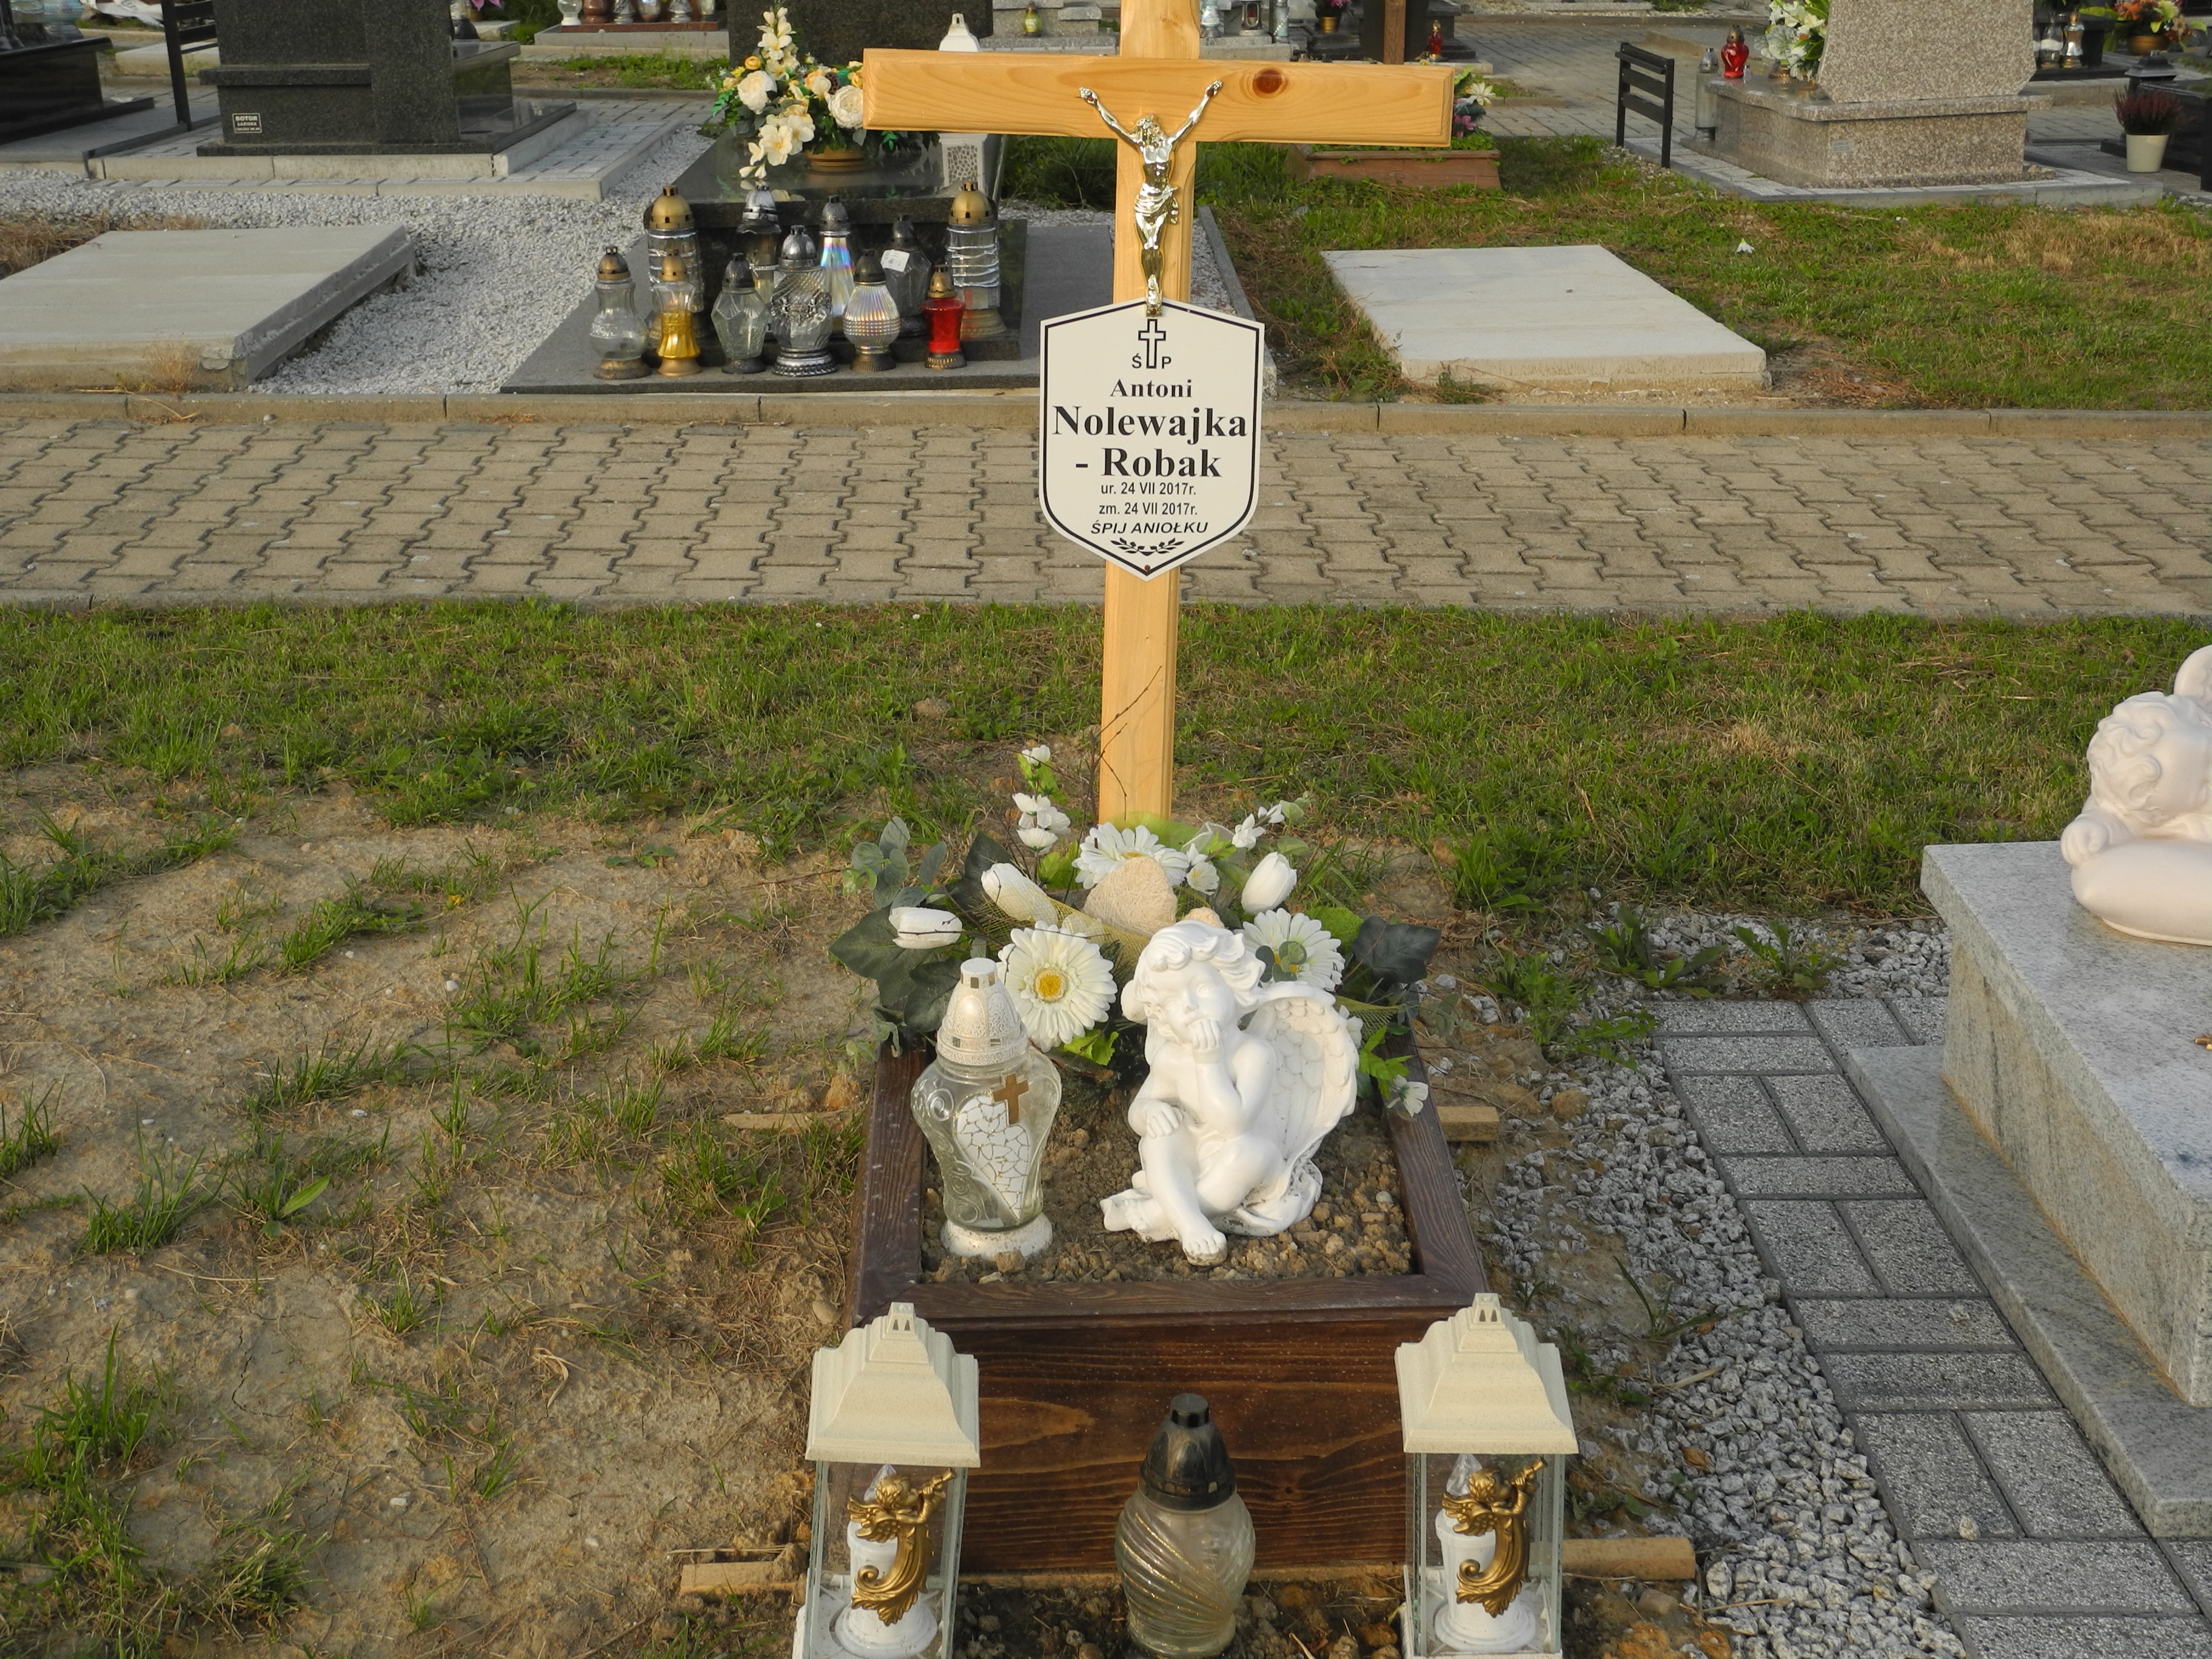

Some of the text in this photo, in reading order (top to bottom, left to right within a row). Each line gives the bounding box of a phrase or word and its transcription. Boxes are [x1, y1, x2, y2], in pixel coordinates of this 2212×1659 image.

[1131, 353, 1172, 369] Ś P
[1110, 379, 1192, 398] Antoni
[1052, 406, 1247, 445] Nolewajka
[1101, 447, 1222, 477] Robak
[1101, 482, 1196, 495] ur. 24 VII 2017r.
[1099, 503, 1198, 515] zm. 24 VII 2017r.
[1091, 520, 1208, 534] ŚPIJ ANIOŁKU
